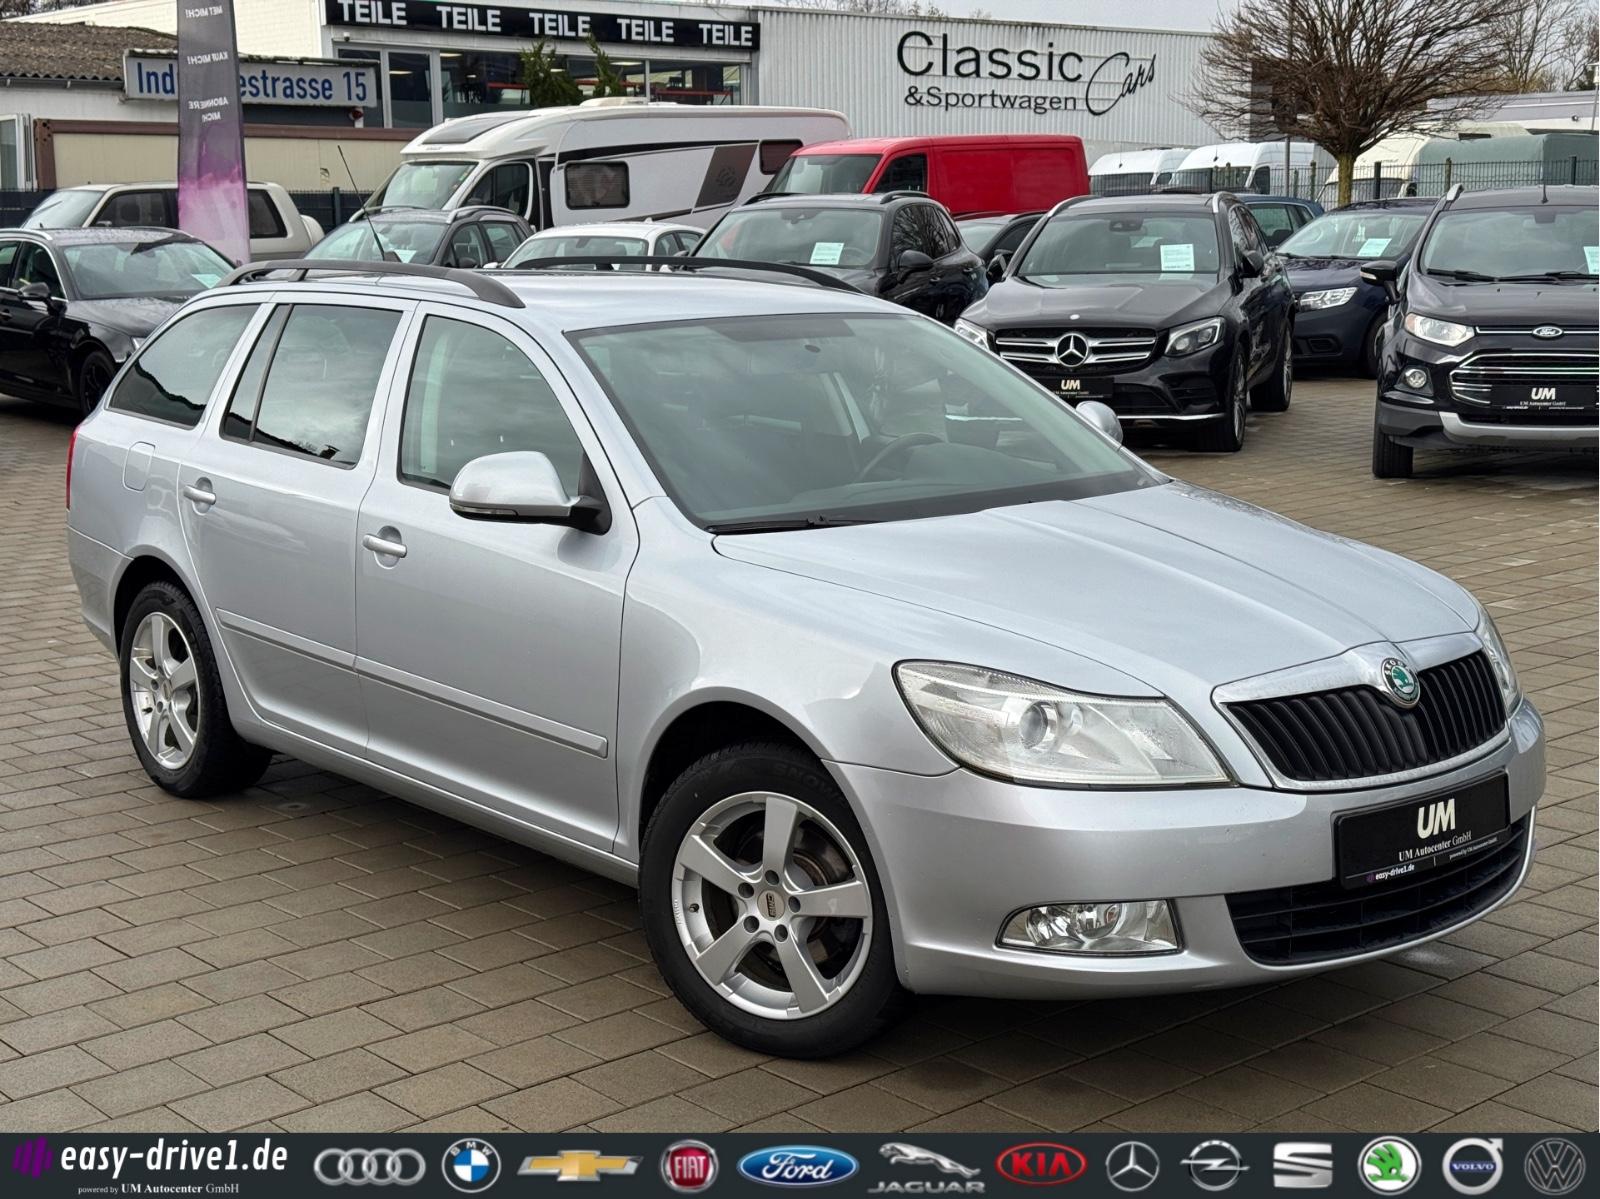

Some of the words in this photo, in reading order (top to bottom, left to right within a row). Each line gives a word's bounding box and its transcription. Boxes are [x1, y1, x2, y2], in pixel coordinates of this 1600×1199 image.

[337, 0, 407, 25] TEILE
[436, 5, 502, 32] TEILE
[529, 12, 591, 37] TEILE
[617, 18, 675, 43] TEILE
[699, 23, 753, 46] TEILE
[897, 30, 1083, 82] Classic
[343, 71, 367, 101] 15
[1061, 379, 1080, 390] UM
[1531, 387, 1556, 400] UM
[1417, 798, 1456, 839] UM
[1399, 849, 1413, 861] UM
[1414, 840, 1452, 858] Autocenter
[1452, 831, 1472, 846] GmbH
